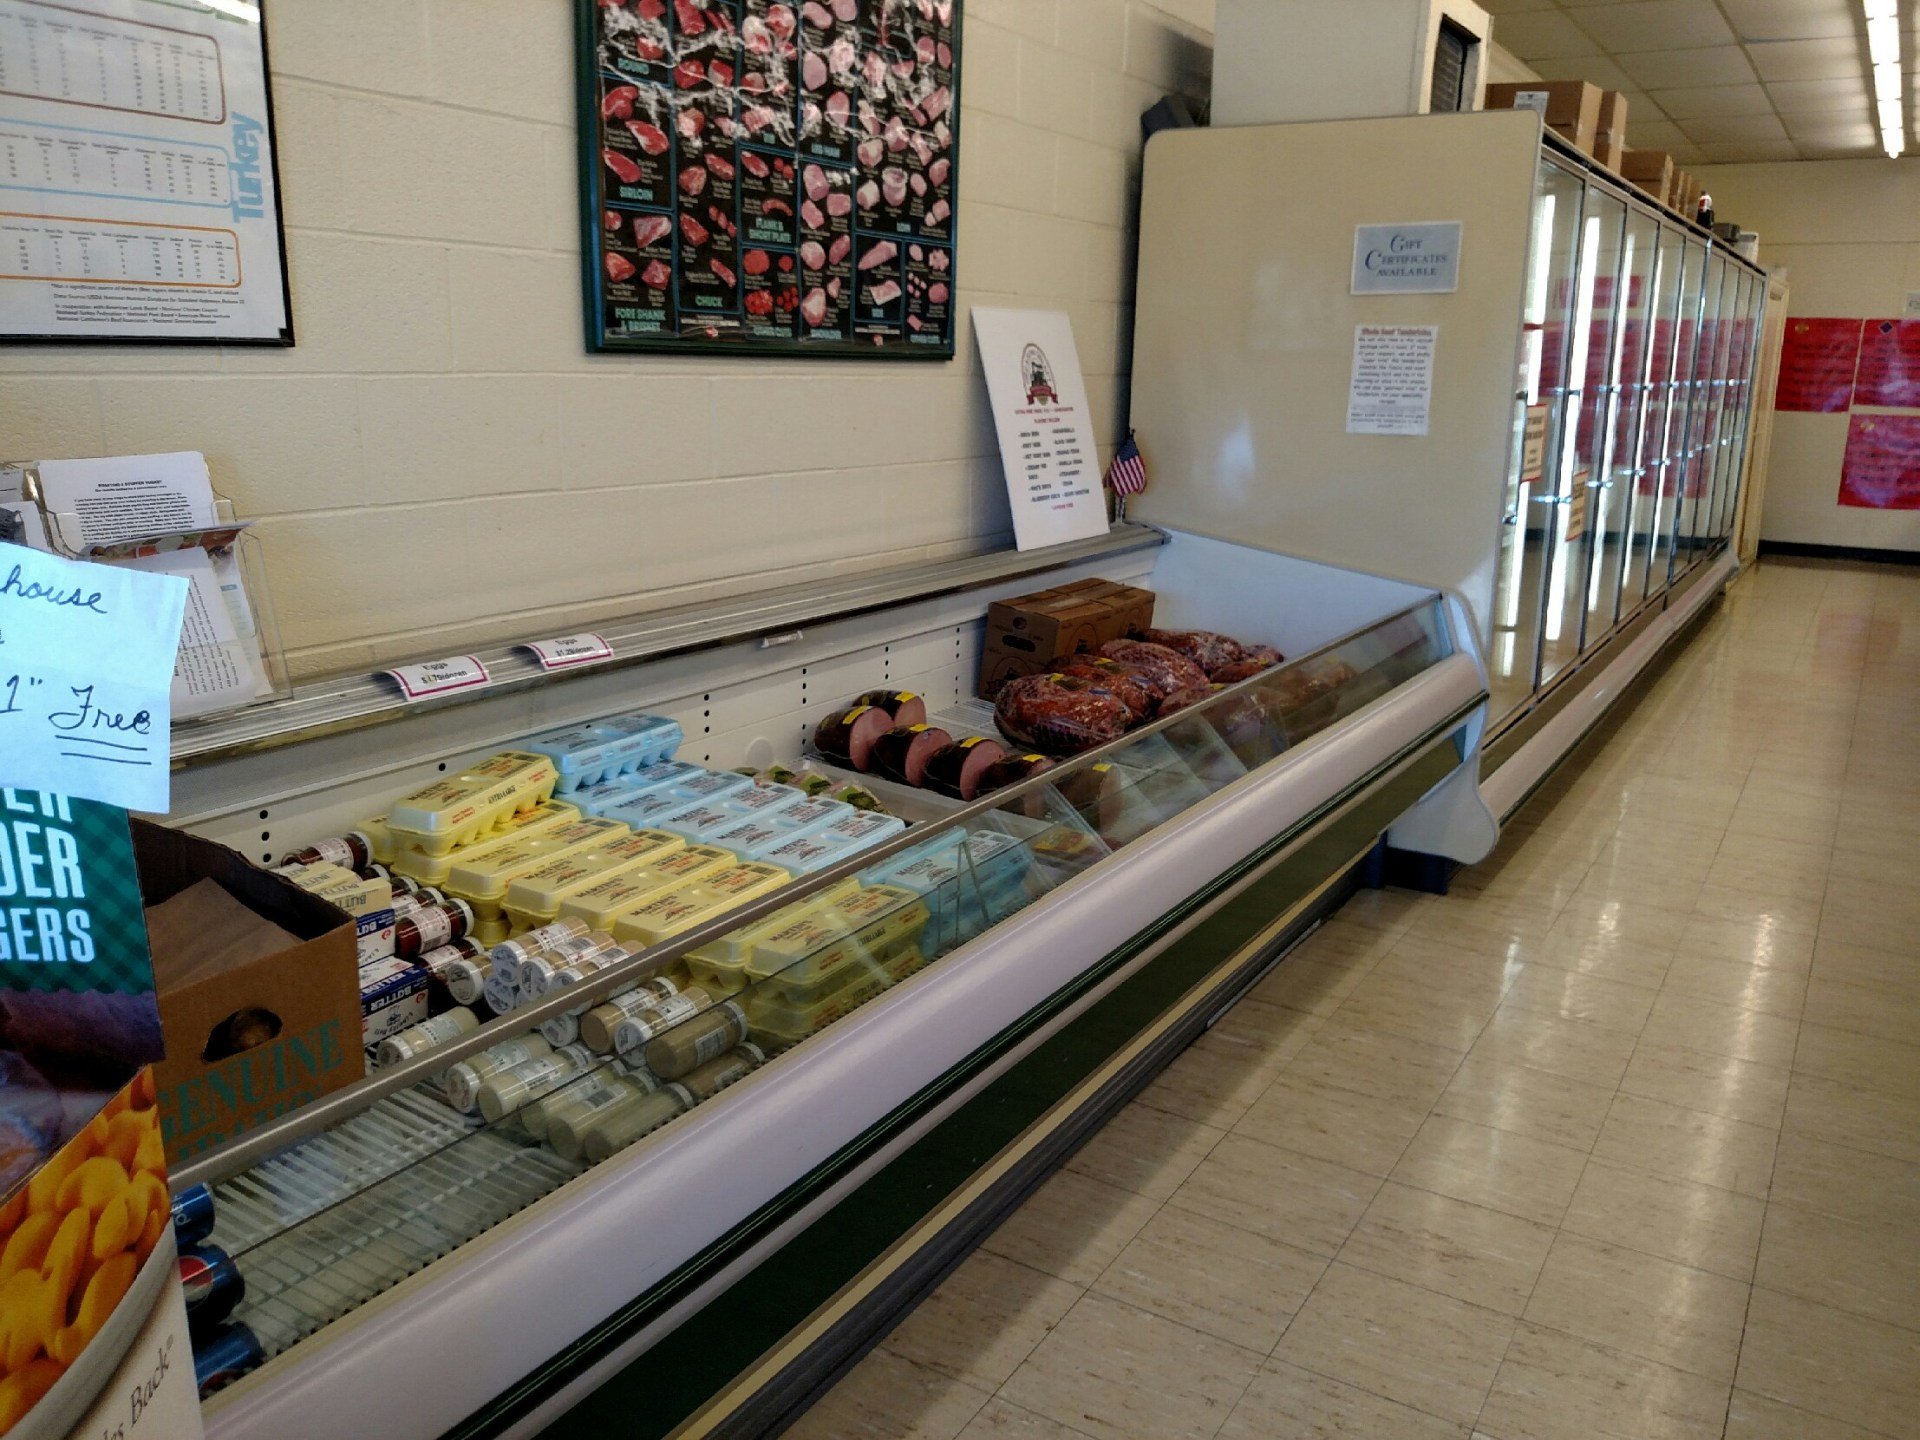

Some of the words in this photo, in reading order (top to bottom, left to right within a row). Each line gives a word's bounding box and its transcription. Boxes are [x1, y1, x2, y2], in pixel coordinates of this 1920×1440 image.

[228, 111, 265, 223] Turkey
[619, 186, 653, 201] SIRLOIN
[773, 231, 792, 243] PLATE
[1390, 235, 1422, 252] GIFT
[1365, 249, 1447, 270] CERTIFICATES
[1377, 268, 1437, 277] AVAILABLE
[695, 295, 723, 307] CHUCK
[615, 308, 636, 320] FORE
[638, 309, 666, 321] SHANK
[1, 563, 108, 614] house
[422, 662, 448, 671] Eggs
[48, 684, 152, 735] Free
